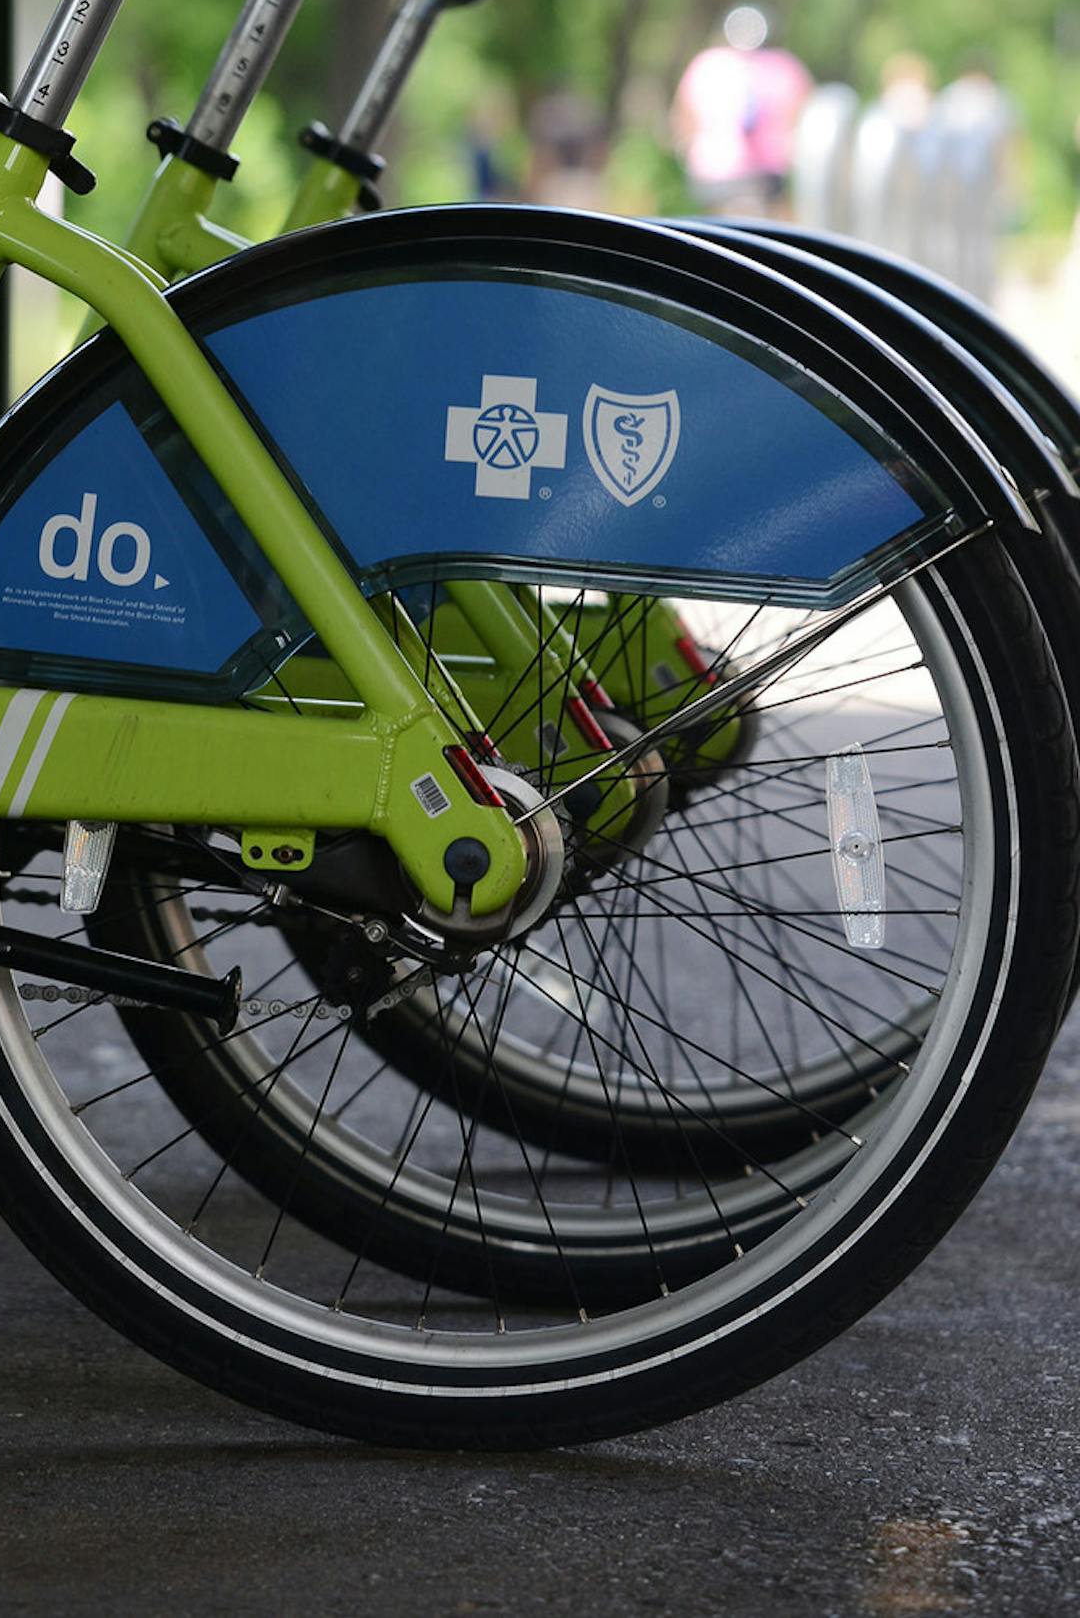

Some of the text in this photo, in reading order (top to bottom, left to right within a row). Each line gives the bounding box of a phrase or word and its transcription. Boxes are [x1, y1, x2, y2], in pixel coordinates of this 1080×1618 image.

[76, 0, 90, 17] 2
[57, 41, 70, 57] 3
[38, 84, 50, 99] 4
